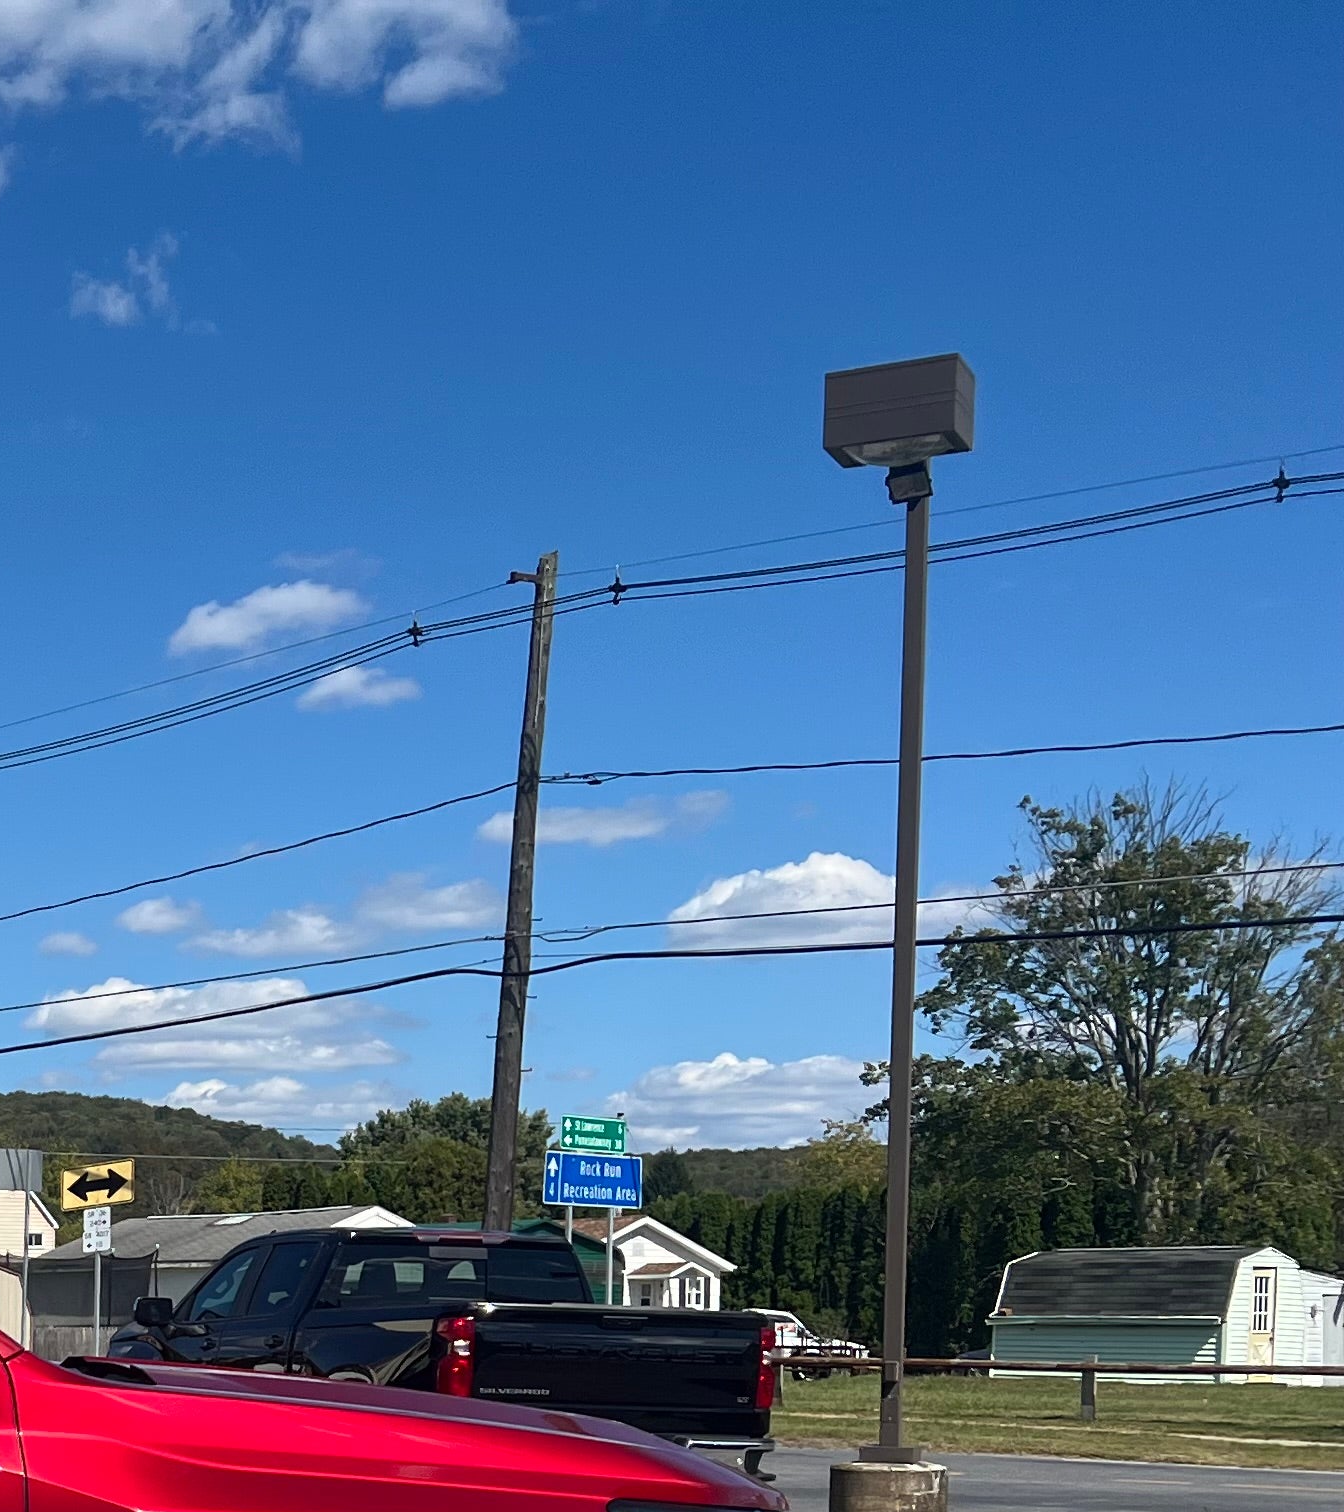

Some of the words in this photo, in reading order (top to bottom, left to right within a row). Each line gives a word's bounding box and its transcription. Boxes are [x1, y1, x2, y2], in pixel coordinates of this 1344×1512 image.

[580, 1160, 601, 1177] Rock
[604, 1162, 622, 1178] Run
[563, 1182, 613, 1199] Recreation
[615, 1186, 637, 1201] Area
